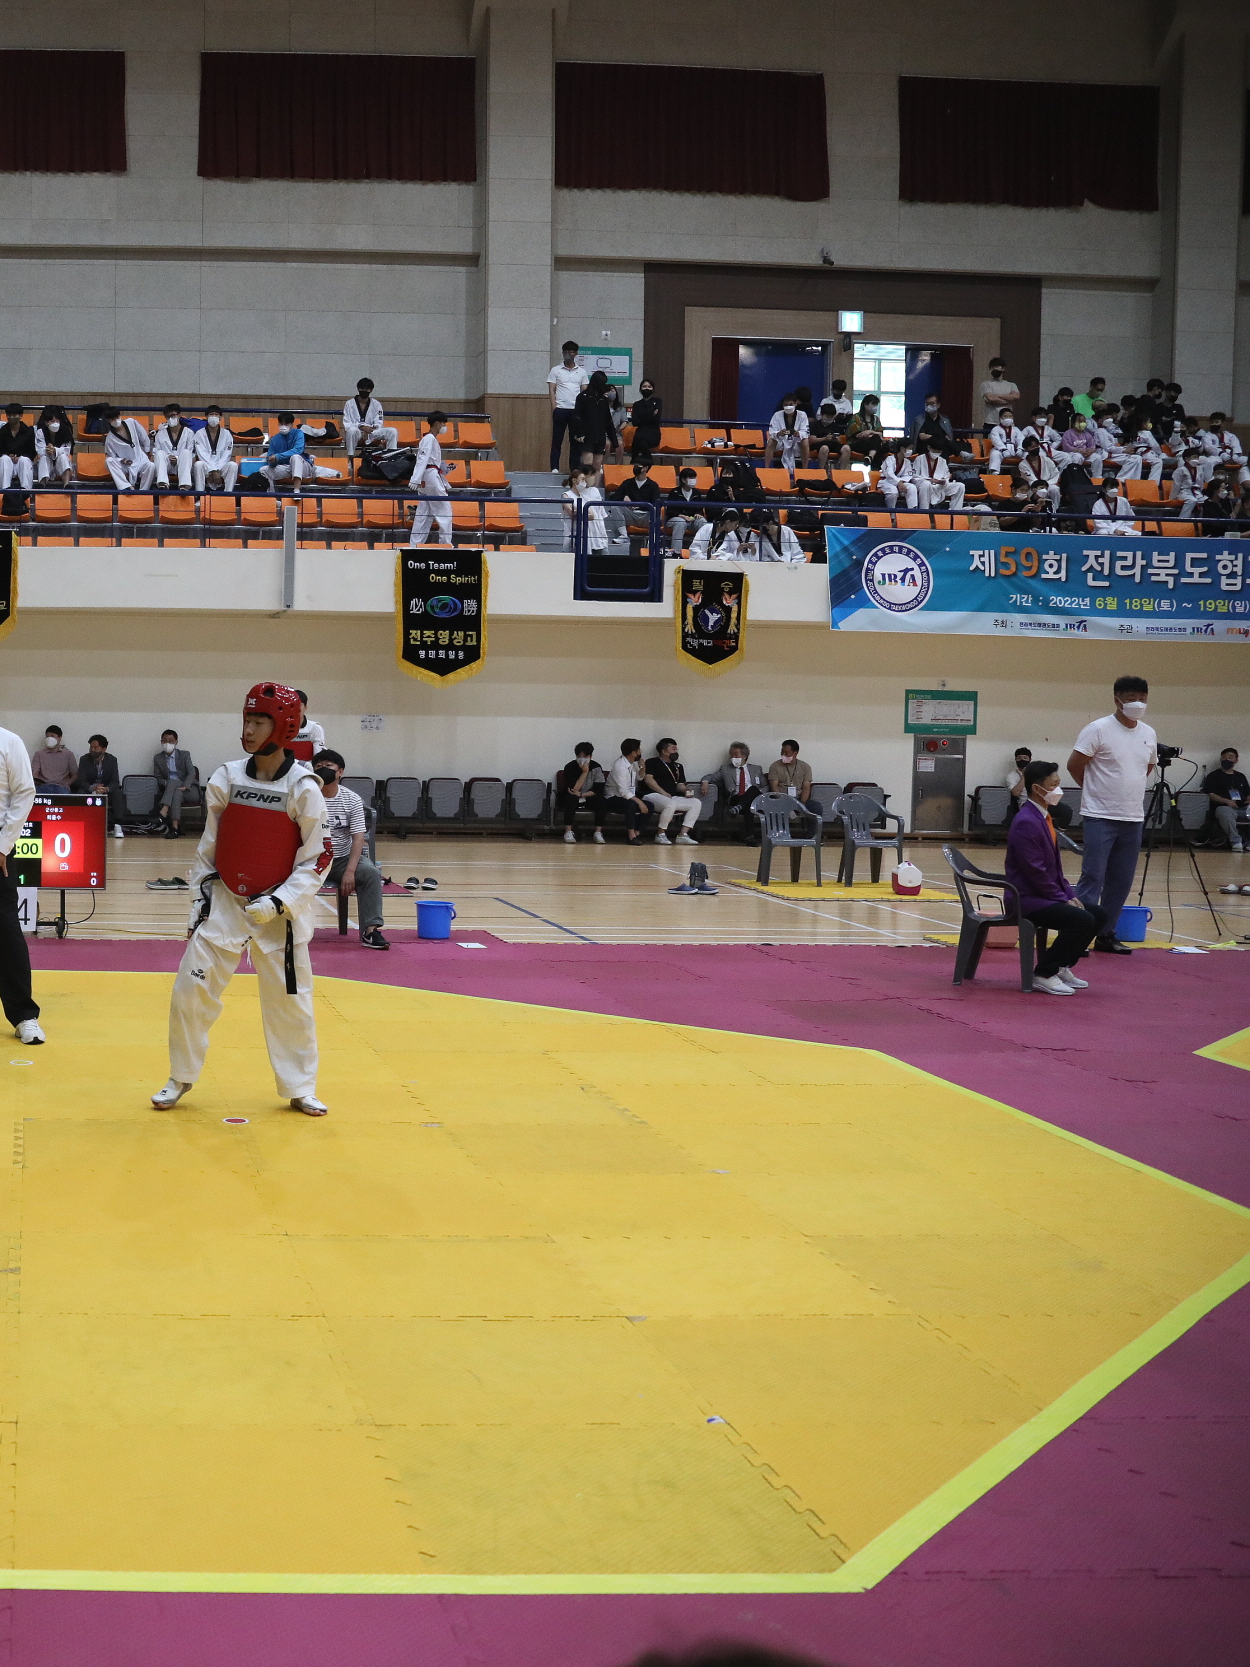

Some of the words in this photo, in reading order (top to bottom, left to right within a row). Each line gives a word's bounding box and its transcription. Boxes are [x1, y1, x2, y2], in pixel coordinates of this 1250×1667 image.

[408, 561, 426, 569] One
[428, 561, 457, 570] Team!
[969, 546, 1068, 582] 제59회
[1081, 550, 1250, 591] 전라북도협
[430, 574, 448, 583] One
[450, 574, 478, 585] Spirit!
[409, 598, 425, 614] 必
[463, 599, 478, 615] 勝
[1009, 594, 1032, 606] 기간
[1049, 596, 1090, 609] 2022년
[1095, 597, 1118, 610] 6월
[1124, 597, 1177, 612] 18일(토)
[1198, 599, 1250, 613] 19일(일)
[992, 619, 1008, 629] 주최
[1118, 624, 1134, 634] 주관
[409, 629, 477, 645] 전주영생고
[43, 797, 52, 805] kg
[233, 789, 282, 804] KPNP
[54, 833, 71, 858] 0
[18, 874, 25, 885] 1
[90, 878, 97, 886] 0
